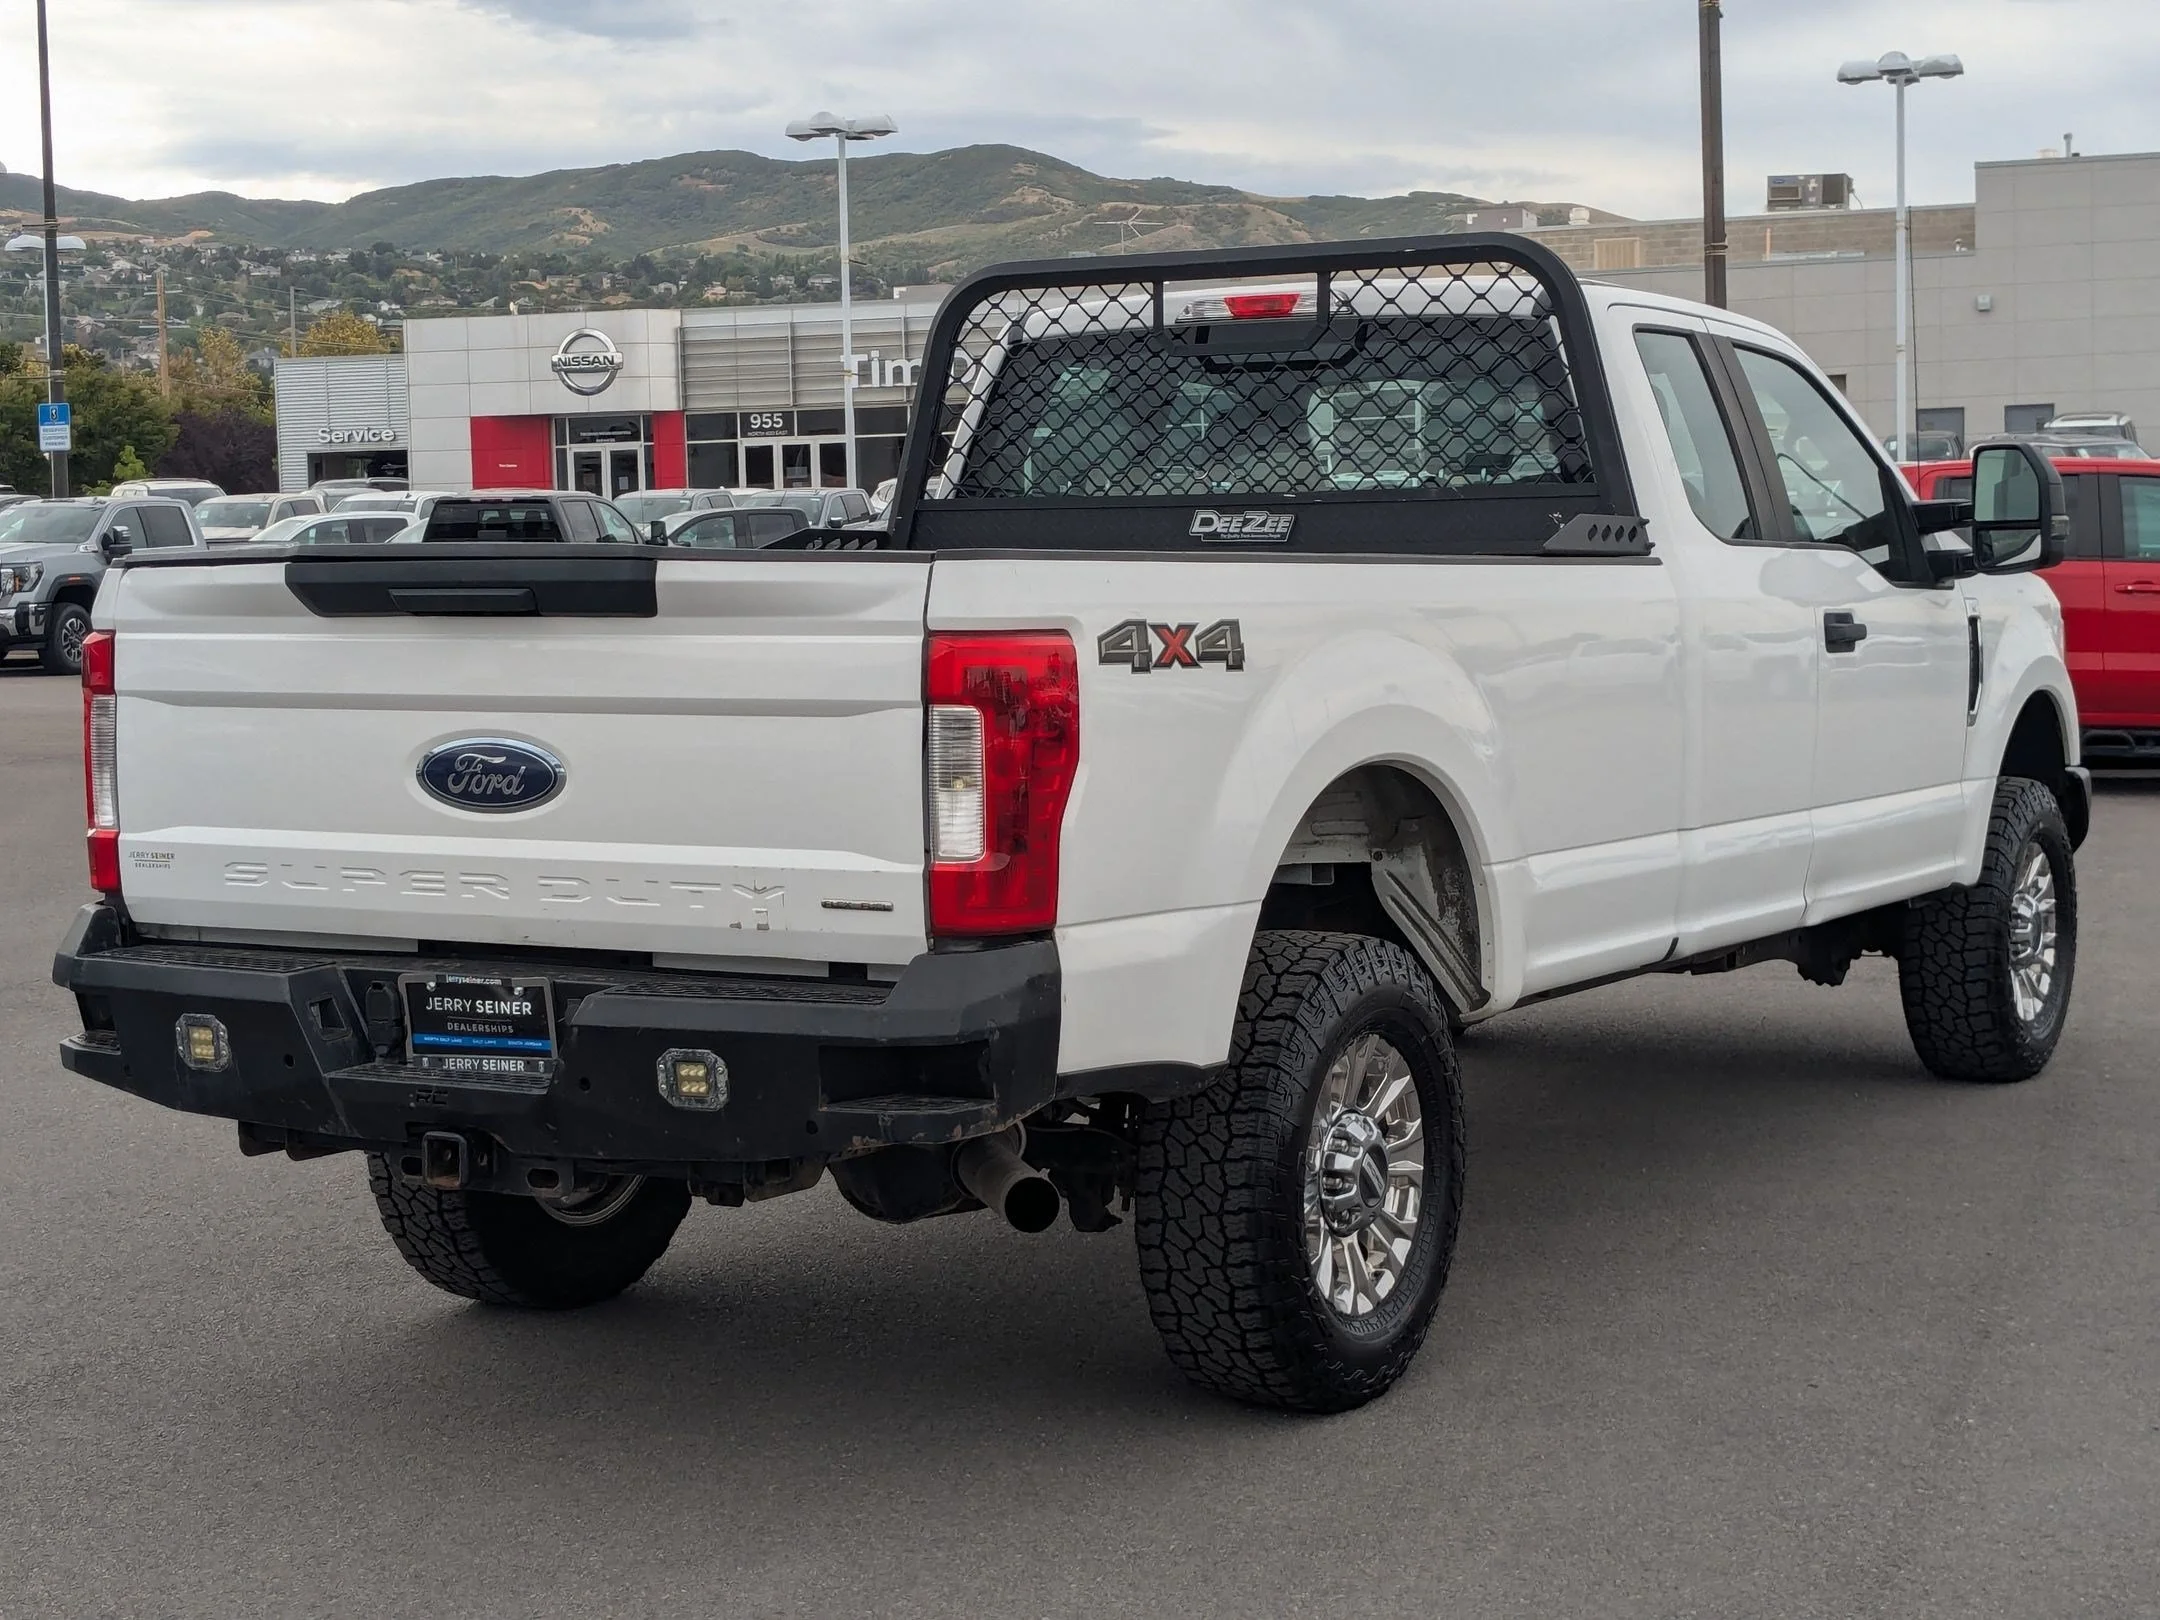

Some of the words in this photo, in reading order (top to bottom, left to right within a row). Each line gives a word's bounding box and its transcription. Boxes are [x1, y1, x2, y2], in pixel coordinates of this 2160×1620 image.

[558, 355, 615, 367] NISSAN
[750, 413, 783, 428] 955
[319, 427, 395, 443] Service
[447, 753, 526, 796] Ford
[224, 861, 510, 900] SUPER
[537, 875, 785, 912] DUTY
[426, 997, 472, 1013] JERRY
[475, 1001, 532, 1016] SEINER
[447, 1022, 514, 1034] DEALERSHIPS
[443, 1058, 480, 1070] JERRY
[482, 1060, 525, 1072] SEINER
